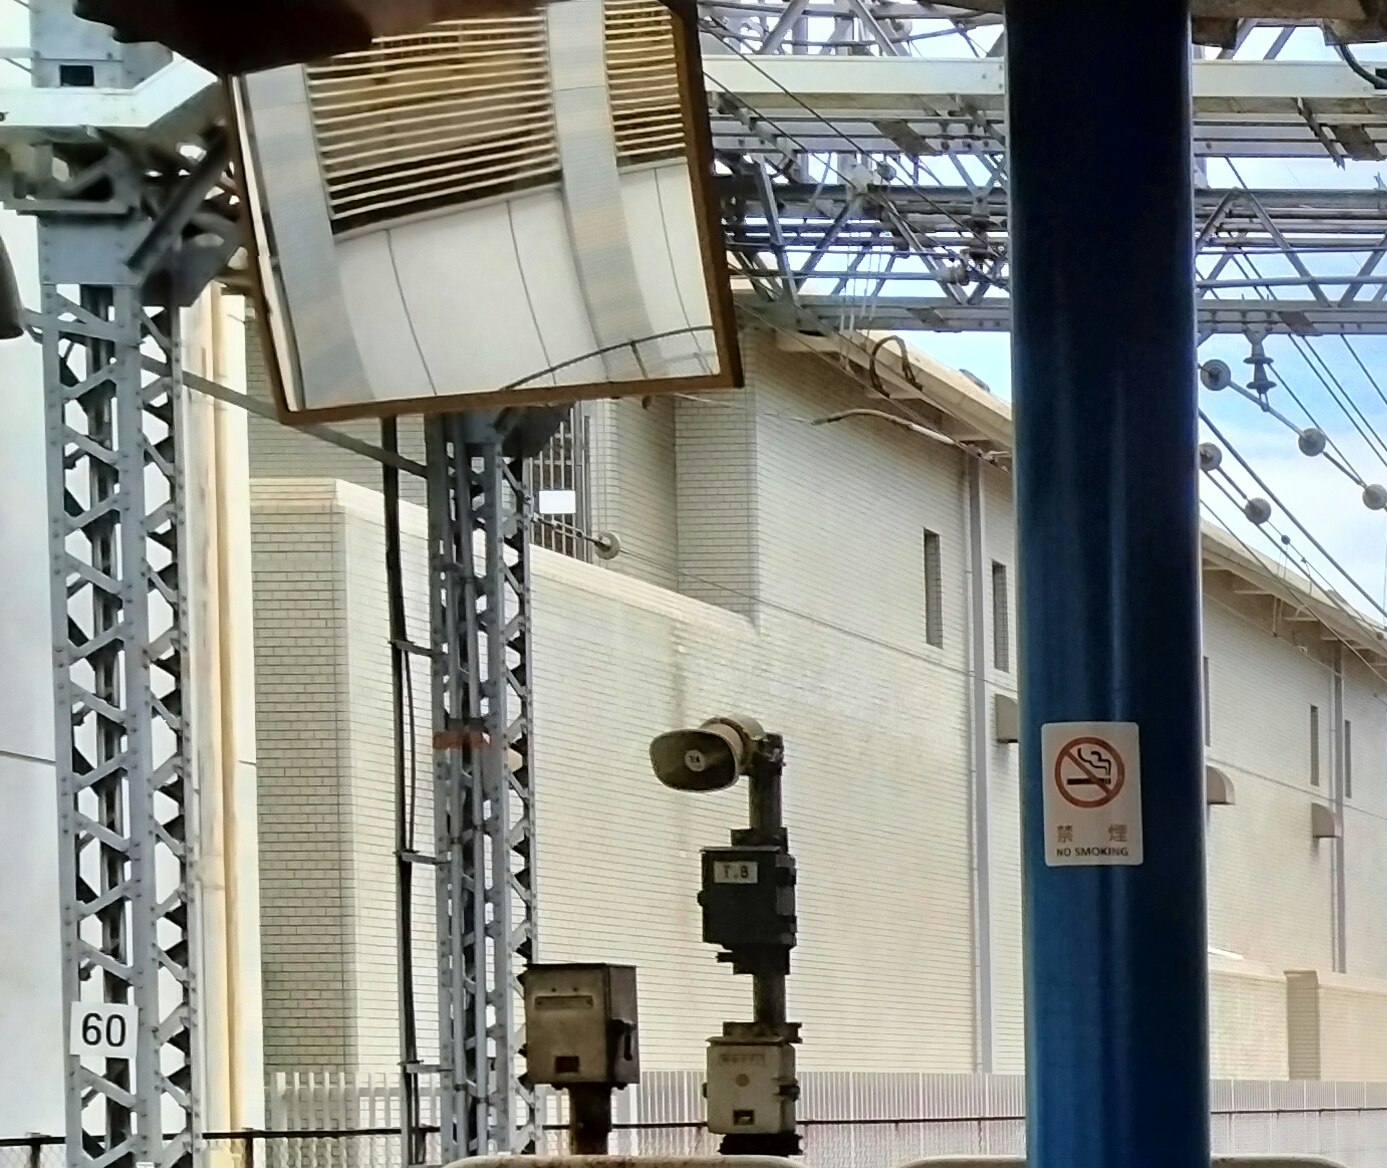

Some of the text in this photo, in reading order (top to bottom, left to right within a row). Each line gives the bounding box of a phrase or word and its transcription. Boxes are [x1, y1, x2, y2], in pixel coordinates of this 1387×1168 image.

[1056, 847, 1129, 857] NO SMOKING
[81, 1012, 127, 1048] 60
